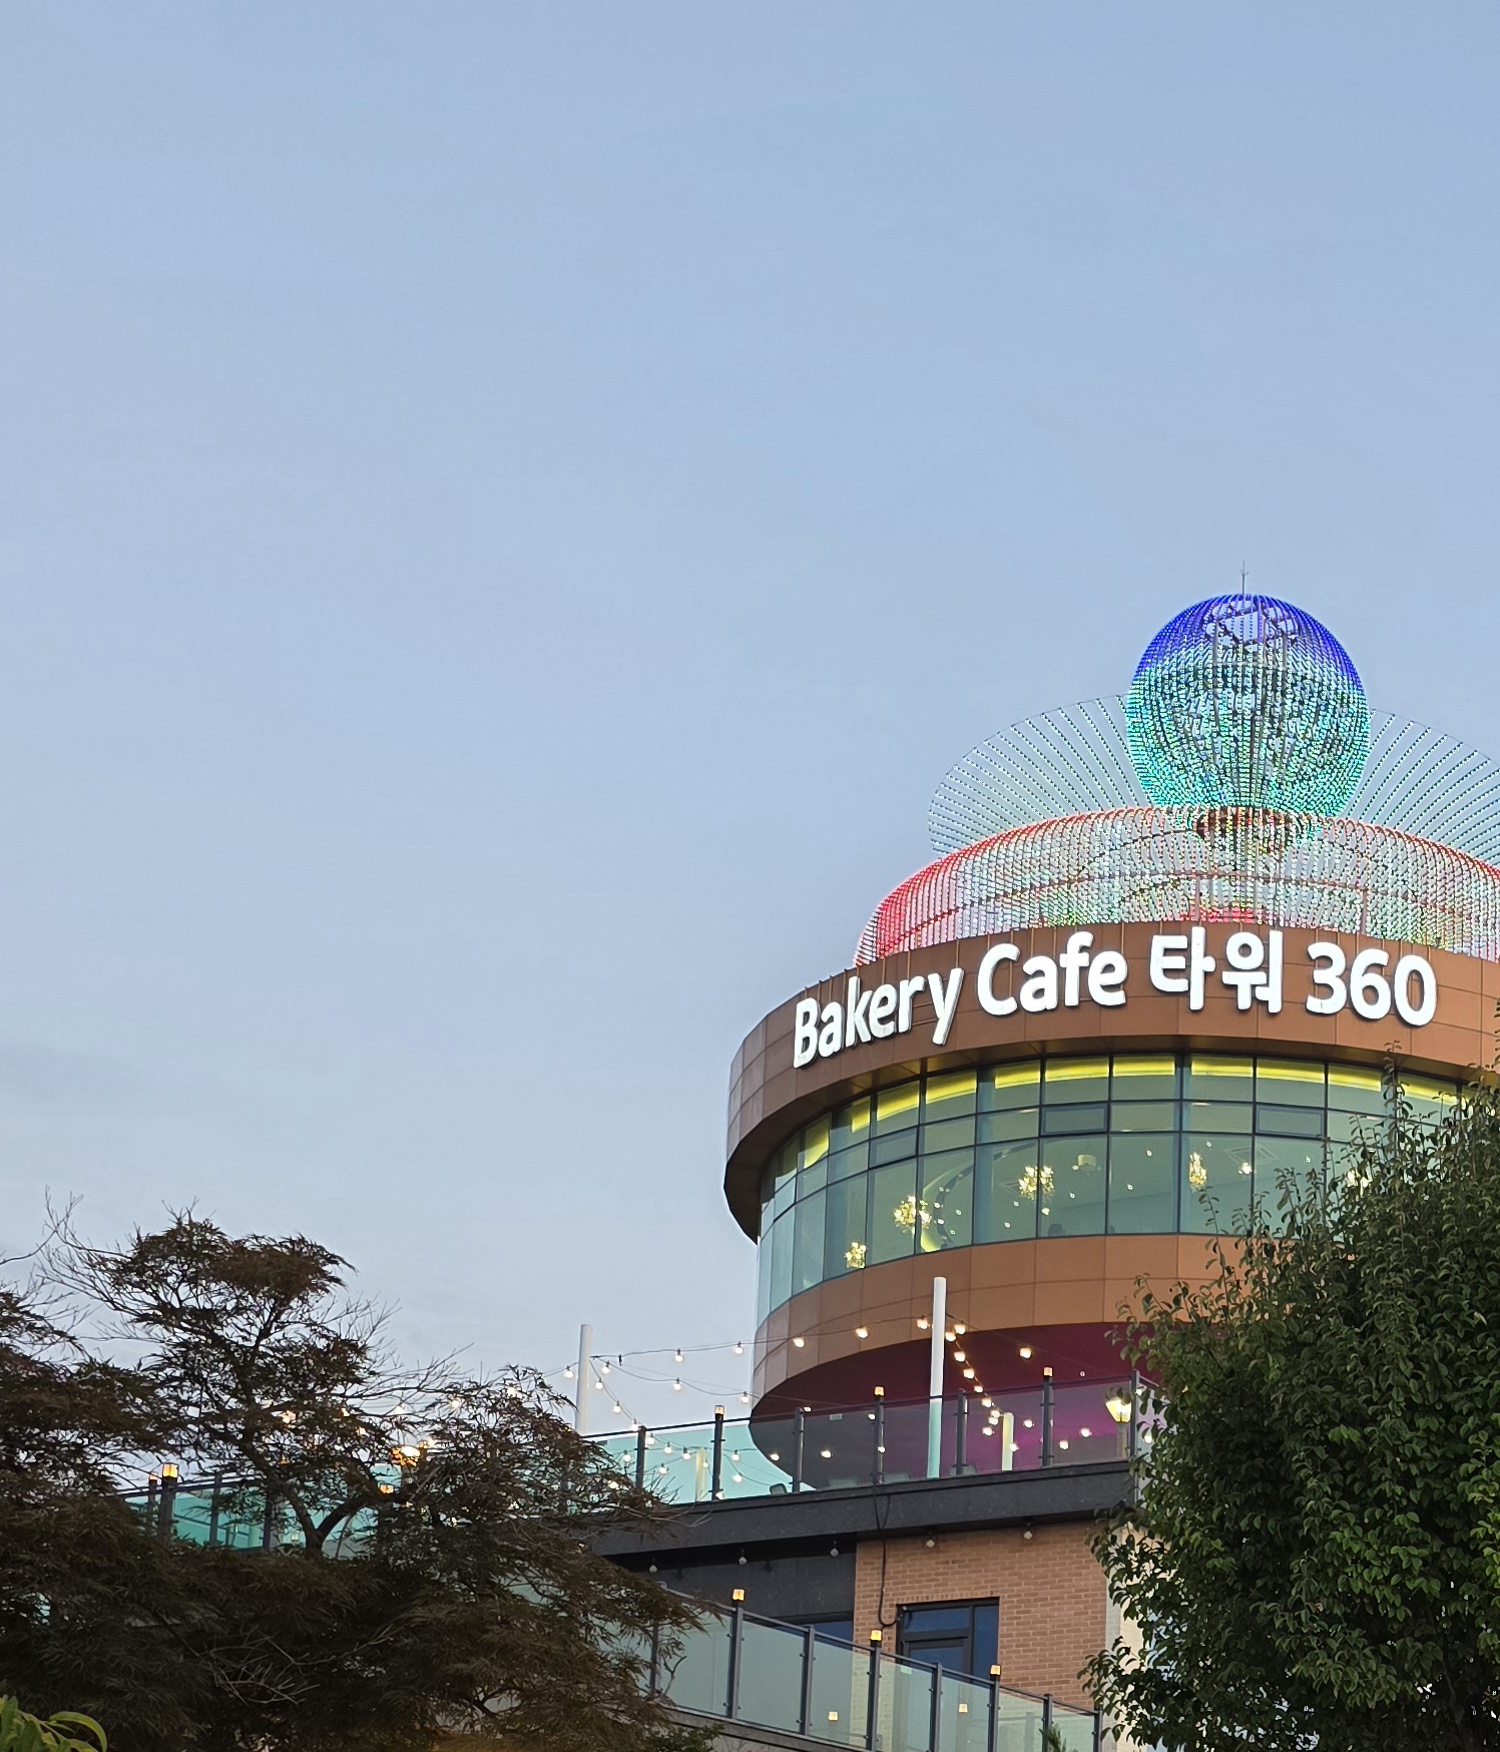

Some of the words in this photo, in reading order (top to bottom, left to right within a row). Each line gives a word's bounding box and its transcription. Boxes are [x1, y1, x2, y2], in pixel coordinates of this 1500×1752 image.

[793, 967, 965, 1069] Bakery
[977, 931, 1127, 1016] Cafe
[1149, 926, 1284, 1014] 타워
[1306, 942, 1437, 1027] 360
